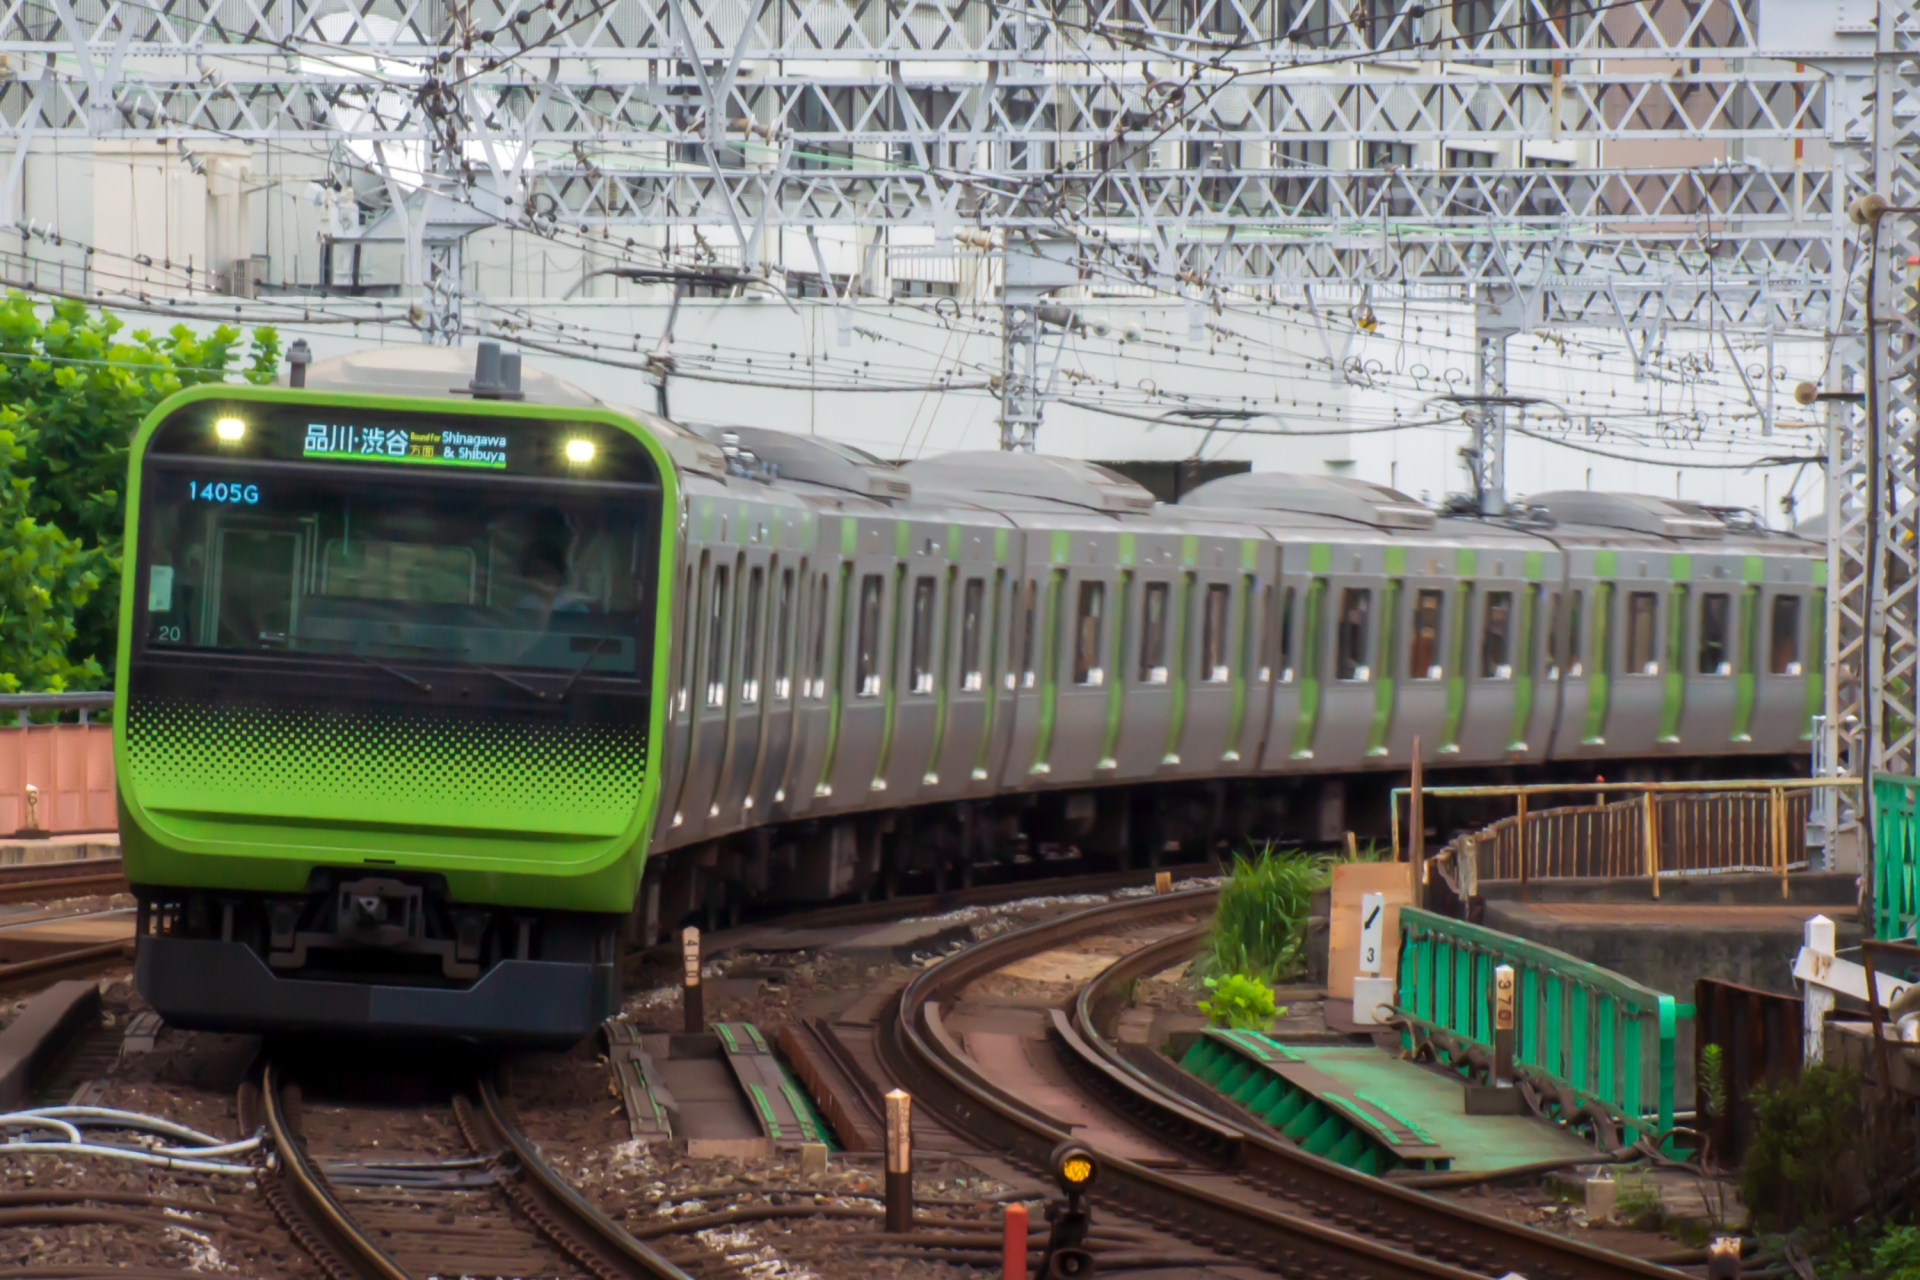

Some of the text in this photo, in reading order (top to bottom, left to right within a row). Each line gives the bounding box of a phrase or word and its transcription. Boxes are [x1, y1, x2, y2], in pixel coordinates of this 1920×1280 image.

[442, 430, 506, 448] Shinagawa
[410, 444, 435, 458] 方面
[443, 446, 506, 464] & Shibuya
[189, 480, 259, 504] 1405G
[159, 626, 181, 641] 20
[1366, 947, 1375, 963] 3
[1498, 980, 1512, 1020] 370
